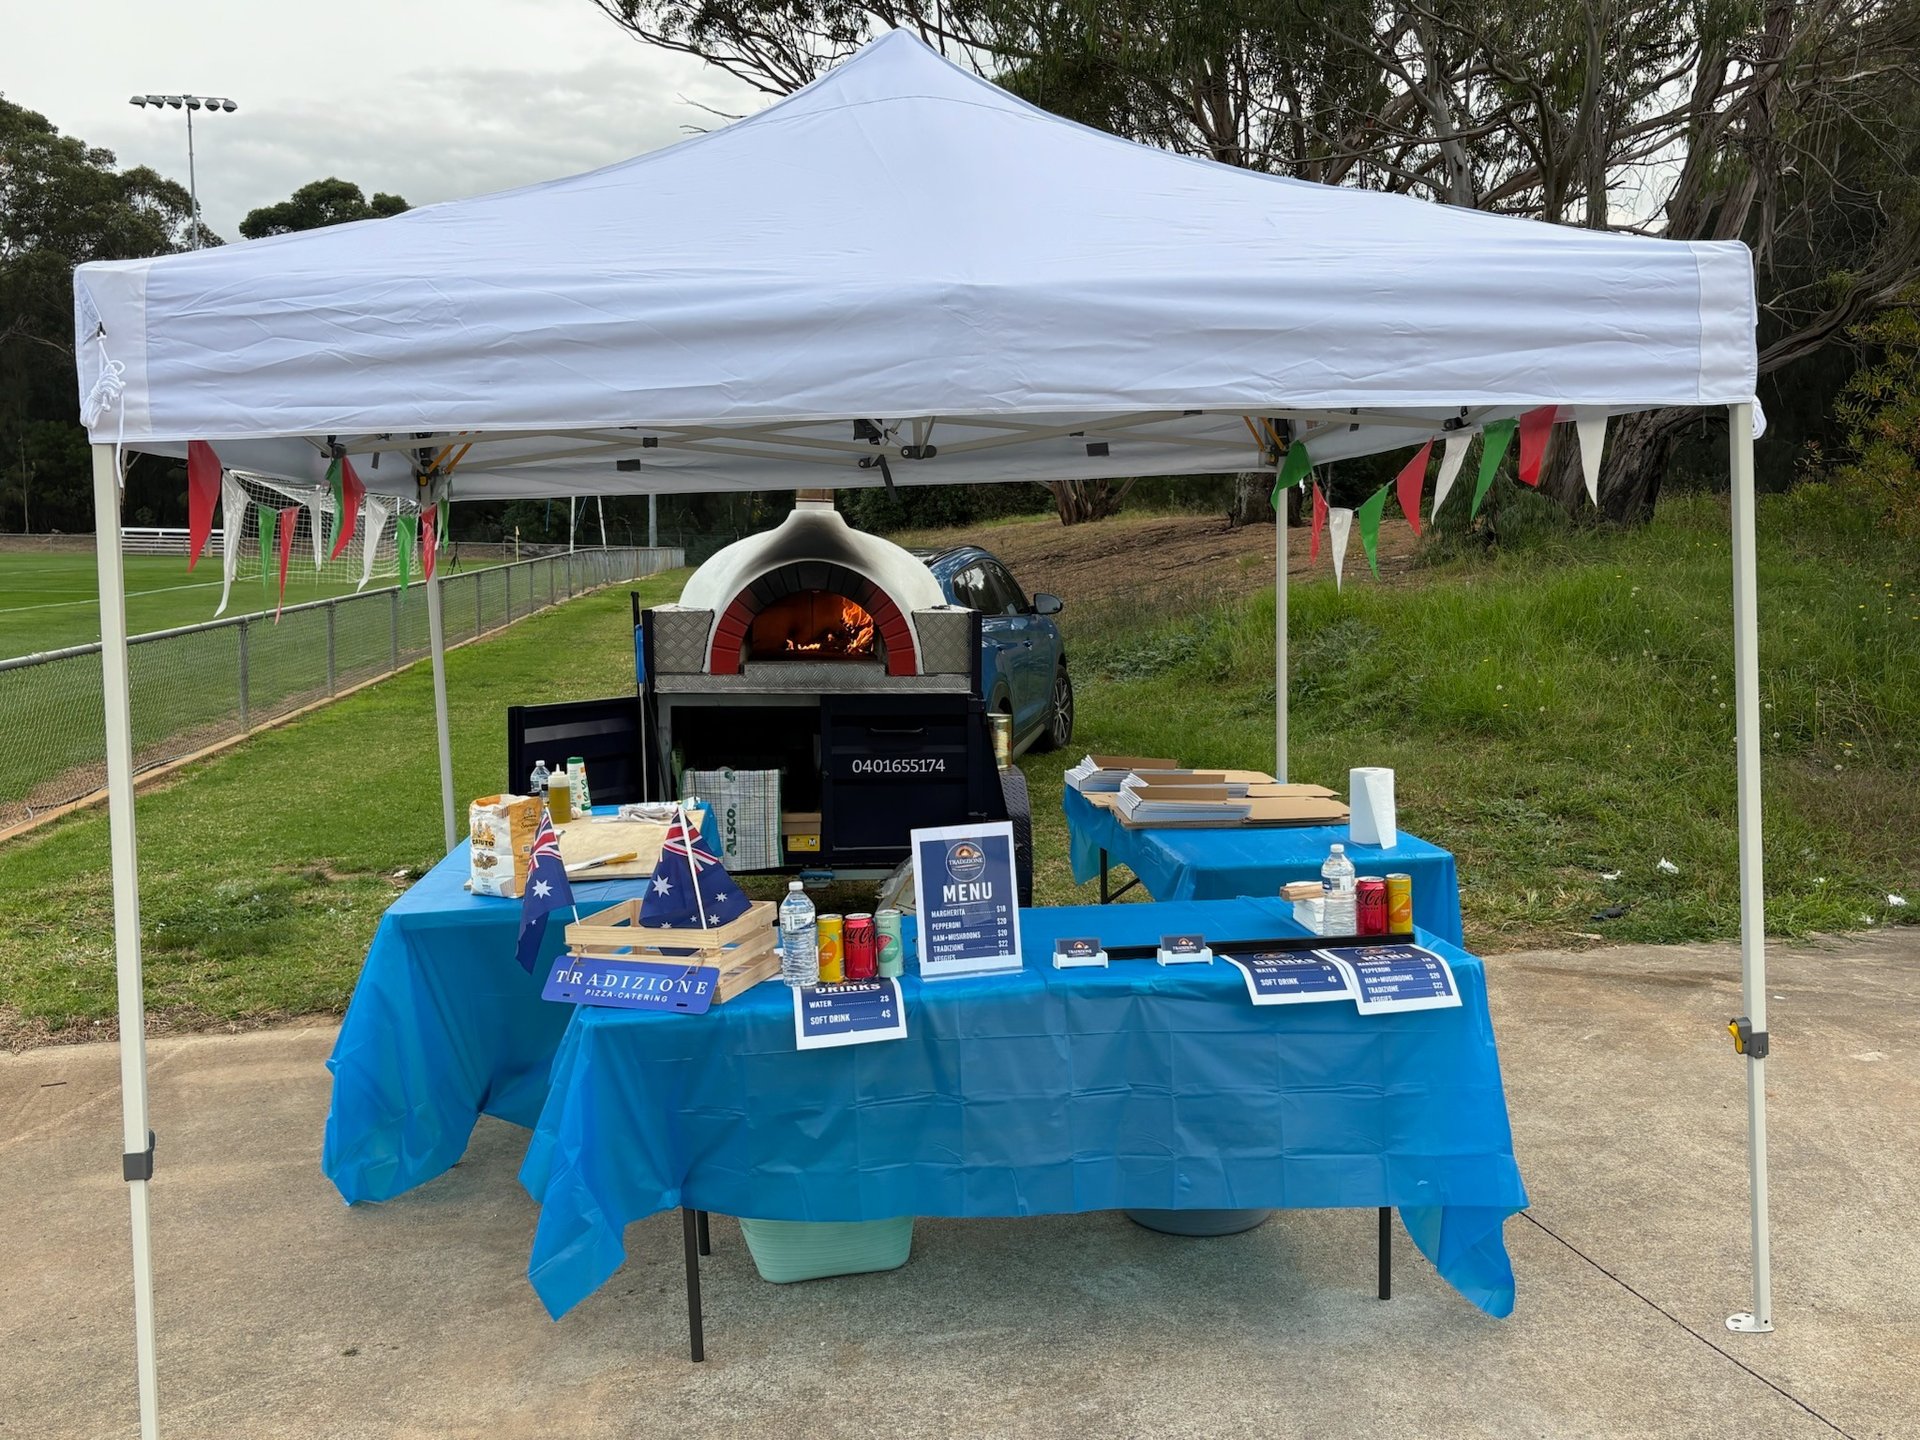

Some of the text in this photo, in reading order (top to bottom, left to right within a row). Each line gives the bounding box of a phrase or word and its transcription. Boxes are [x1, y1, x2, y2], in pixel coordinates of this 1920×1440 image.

[852, 759, 946, 773] 0401655174
[726, 808, 737, 857] ALSCO
[943, 881, 993, 903] MENU
[931, 908, 966, 918] MARGHERITA
[932, 917, 1007, 931] PEPPERONI $20
[932, 929, 1008, 942] HAM+MUSHROOMS $20
[933, 940, 1008, 953] TRADIZIONE $22
[556, 969, 709, 995] TRADIZIONE
[1260, 978, 1278, 986] SOFT
[1278, 977, 1299, 986] DRINK
[815, 983, 881, 994] DRINKS
[1367, 985, 1400, 994] TRADIZIONE
[809, 1000, 832, 1009] WATER
[810, 1015, 828, 1025] SOFT
[829, 1013, 850, 1023] DRINK
